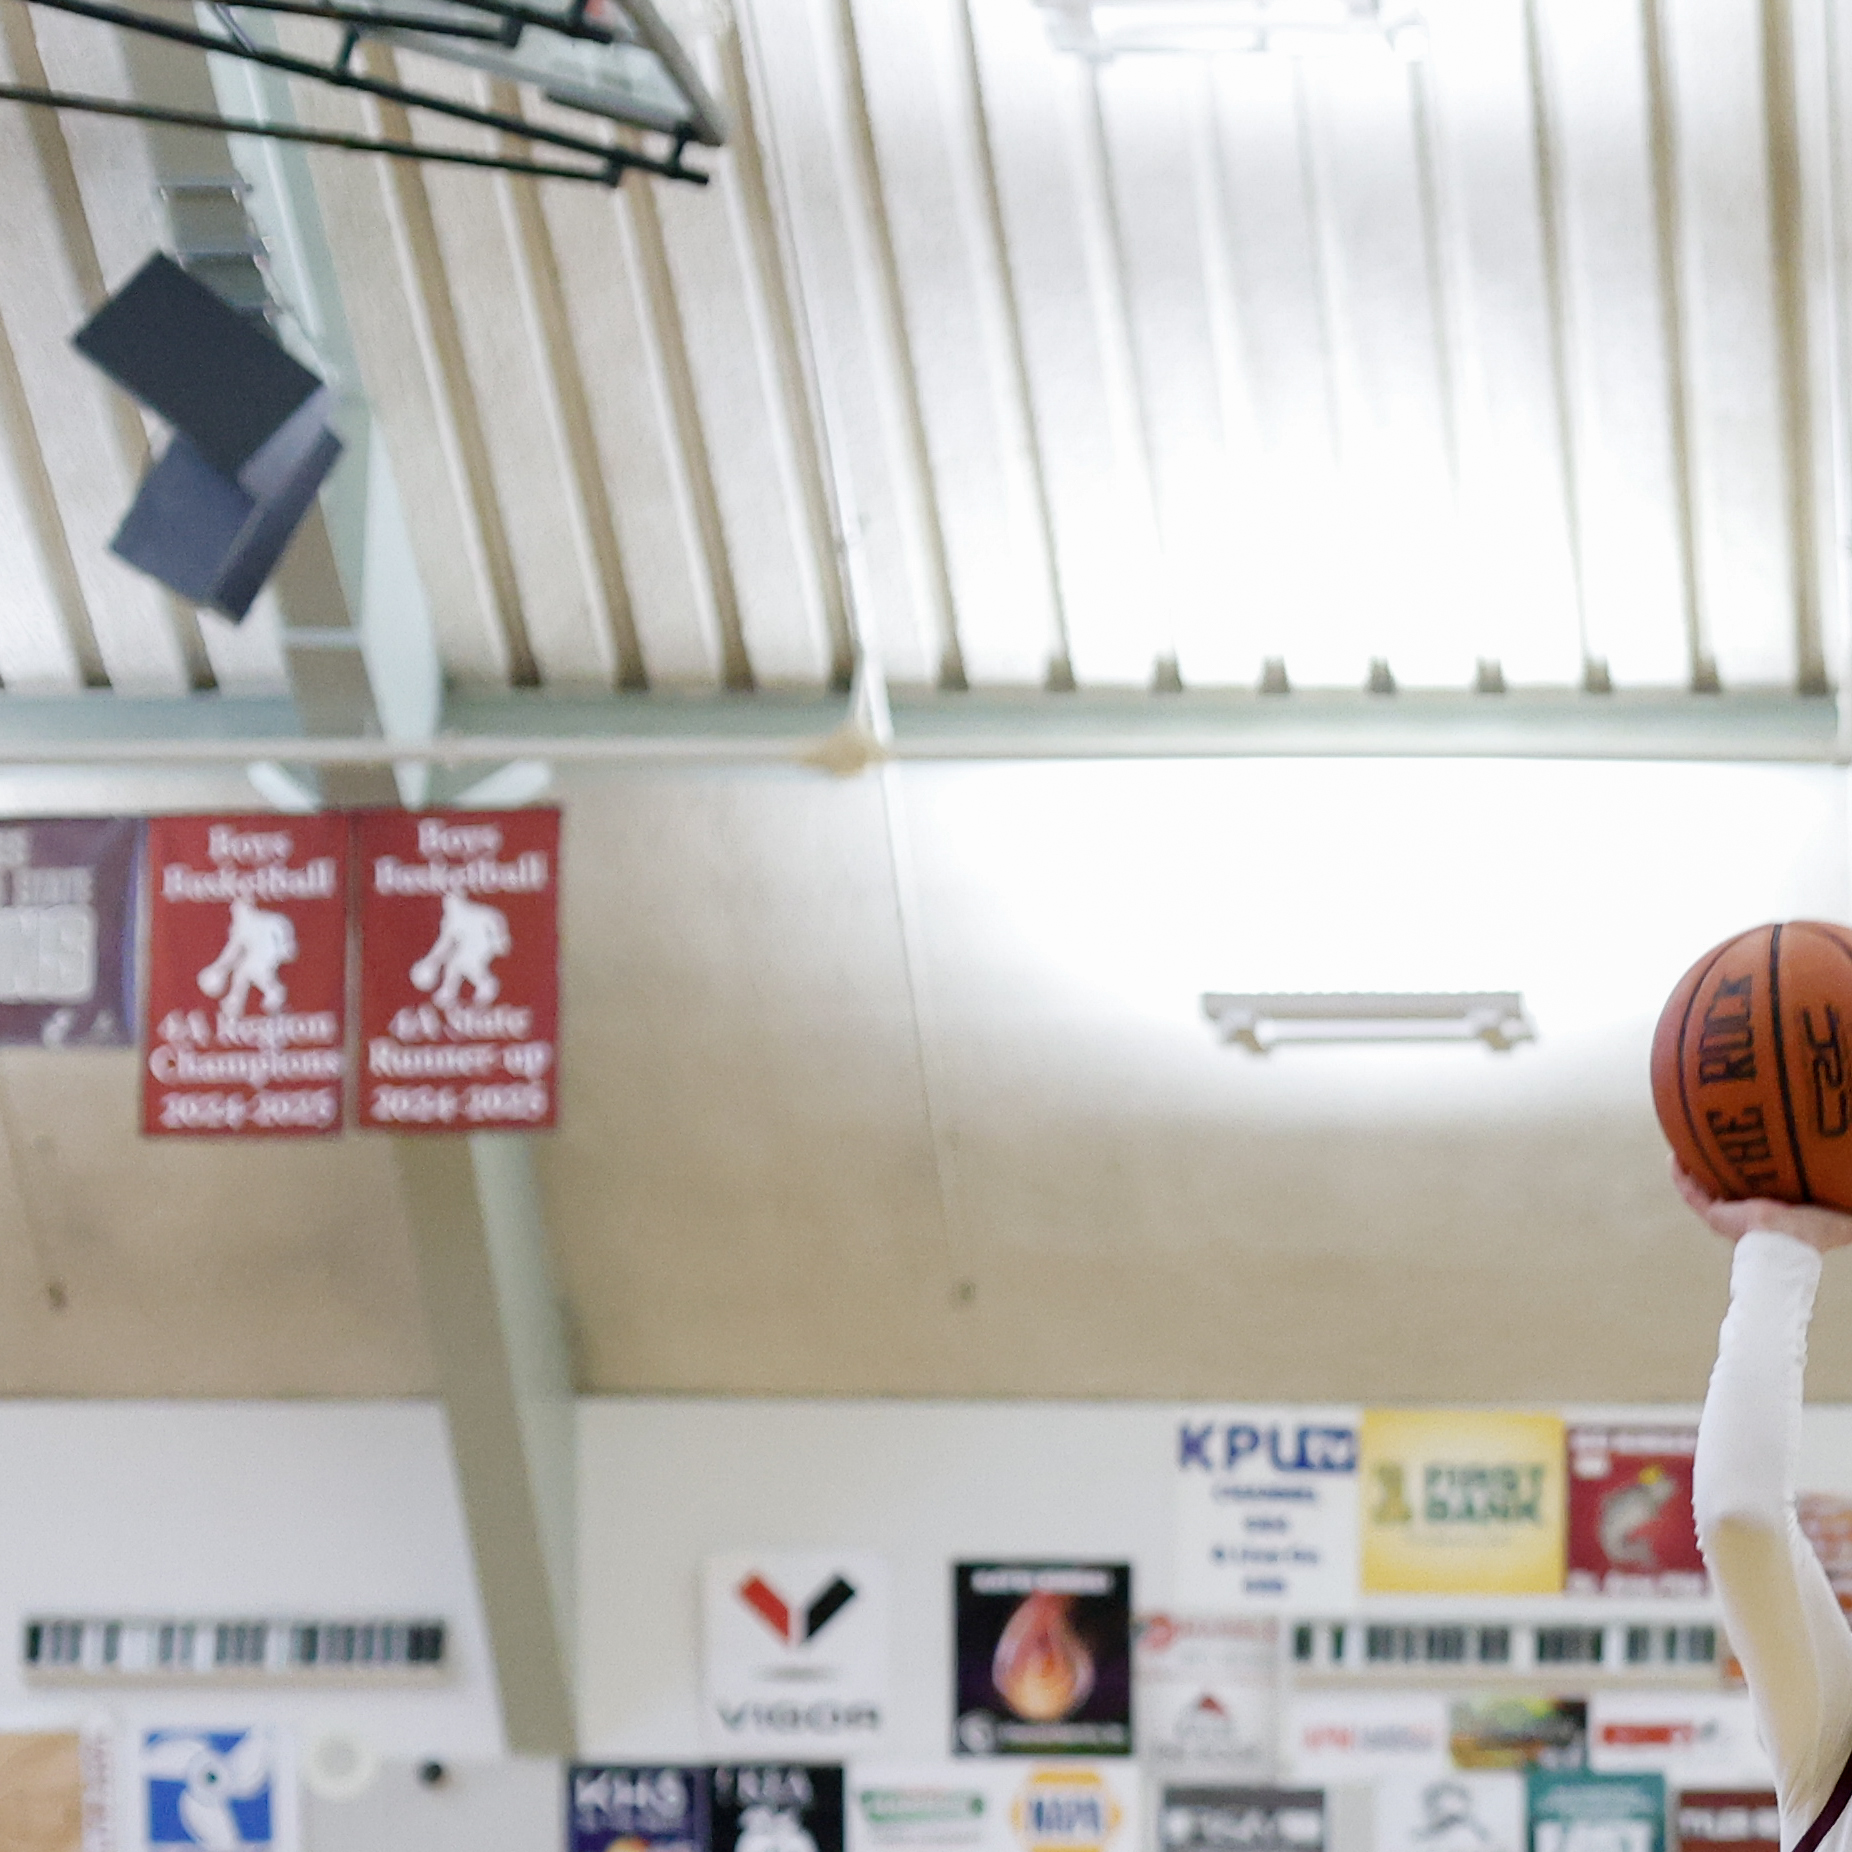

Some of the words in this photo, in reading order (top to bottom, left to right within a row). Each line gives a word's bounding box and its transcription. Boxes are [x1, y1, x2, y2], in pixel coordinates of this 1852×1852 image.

[163, 857, 337, 899] Basketball
[375, 853, 549, 896] Basketball
[149, 1045, 345, 1088] Champions
[1424, 1463, 1547, 1491] FIRST
[1424, 1492, 1543, 1526] BANK
[717, 1702, 880, 1732] VIGOR
